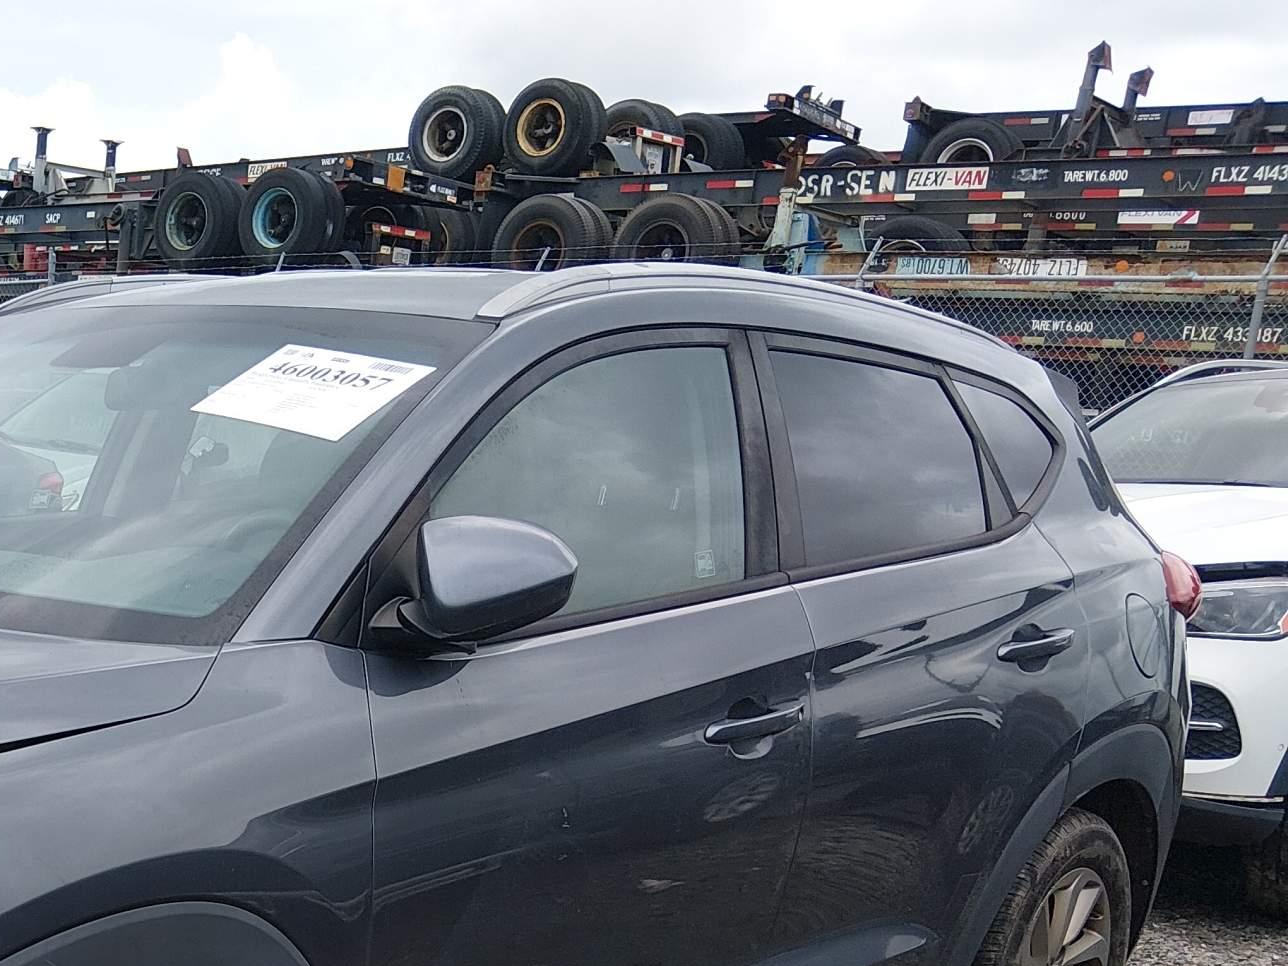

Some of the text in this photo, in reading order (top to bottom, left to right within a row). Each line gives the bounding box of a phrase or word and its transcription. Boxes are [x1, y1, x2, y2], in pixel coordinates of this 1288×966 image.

[908, 169, 987, 187] FLEXI-VAN
[1211, 166, 1250, 183] FLXZ
[45, 213, 61, 225] SACP
[1182, 326, 1218, 341] FLXZ
[269, 361, 394, 391] 46003057
